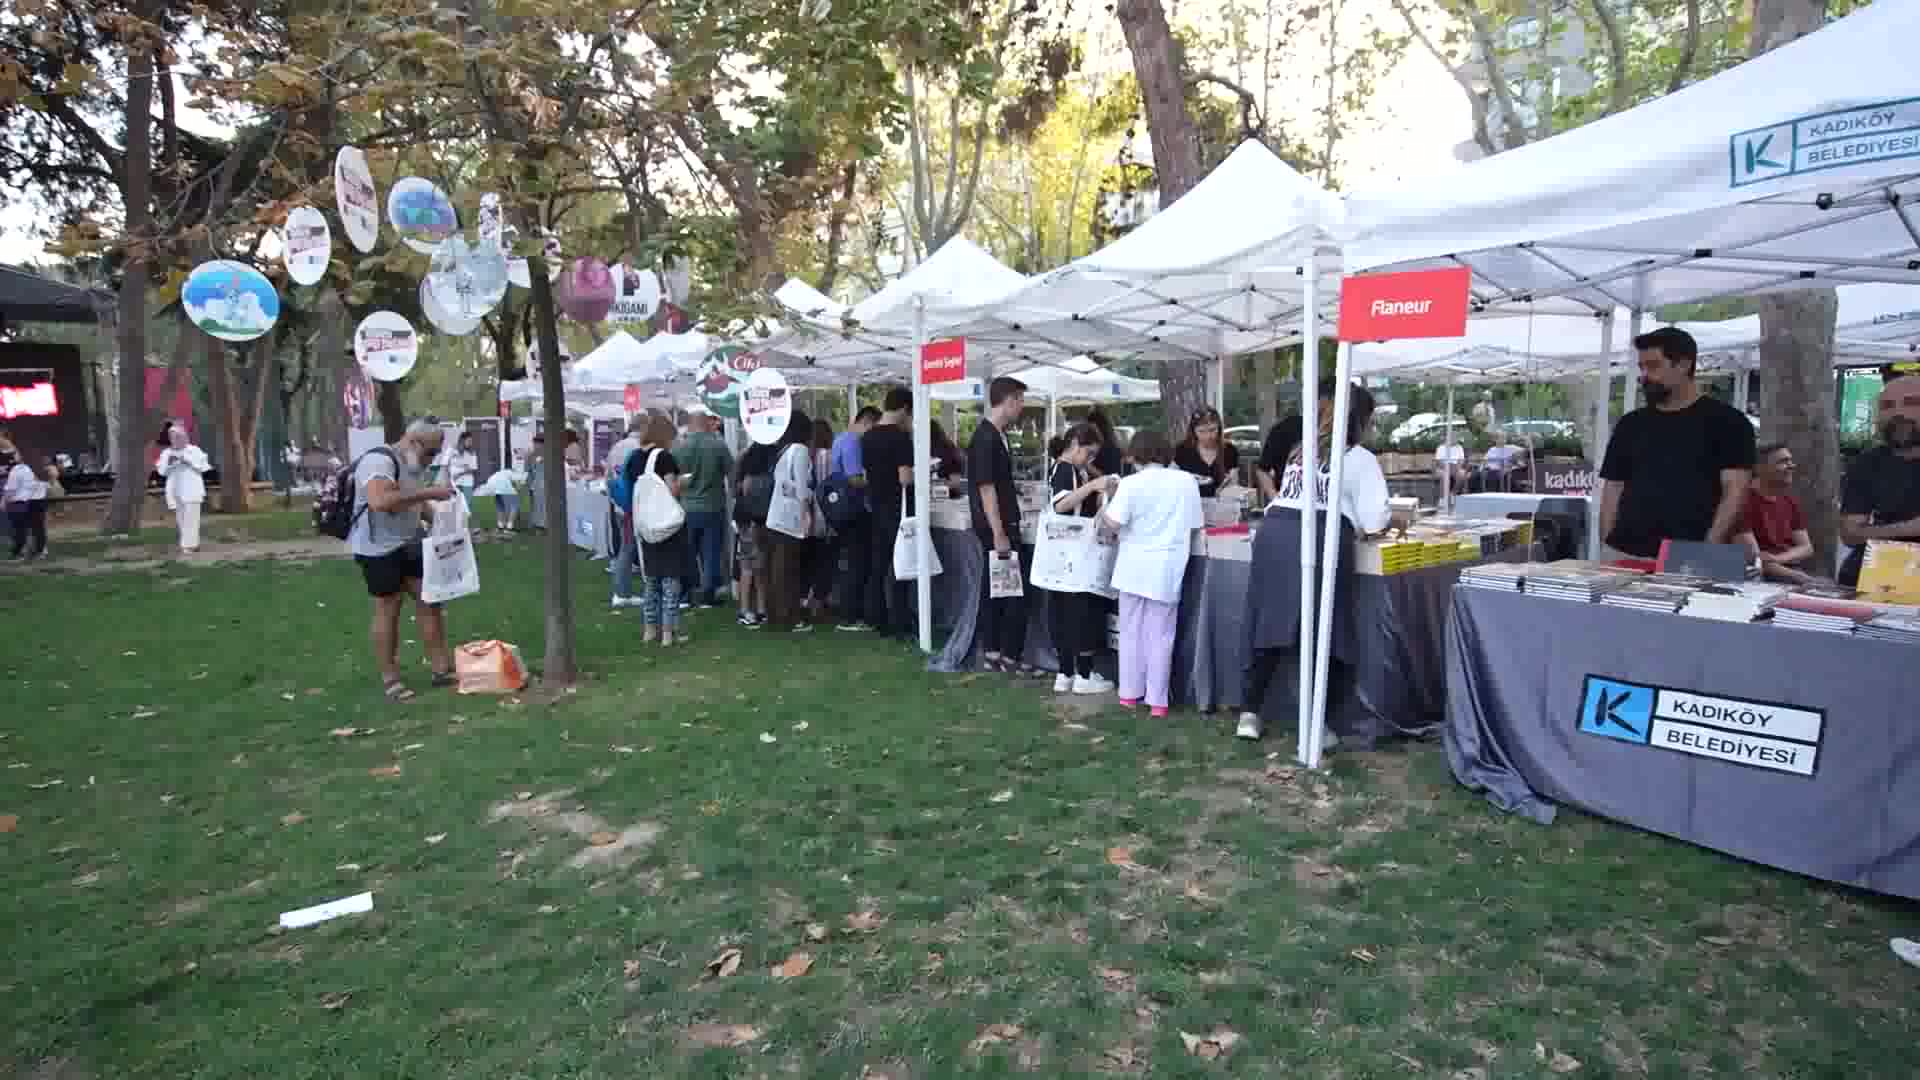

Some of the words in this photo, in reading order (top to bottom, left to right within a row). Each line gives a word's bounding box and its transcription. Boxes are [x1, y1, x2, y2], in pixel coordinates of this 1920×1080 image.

[1808, 112, 1895, 136] KADIKÖY
[1372, 299, 1432, 316] Flaneur
[1672, 699, 1773, 728] KADIKÖY
[1666, 729, 1798, 766] BELEDİYESİ
